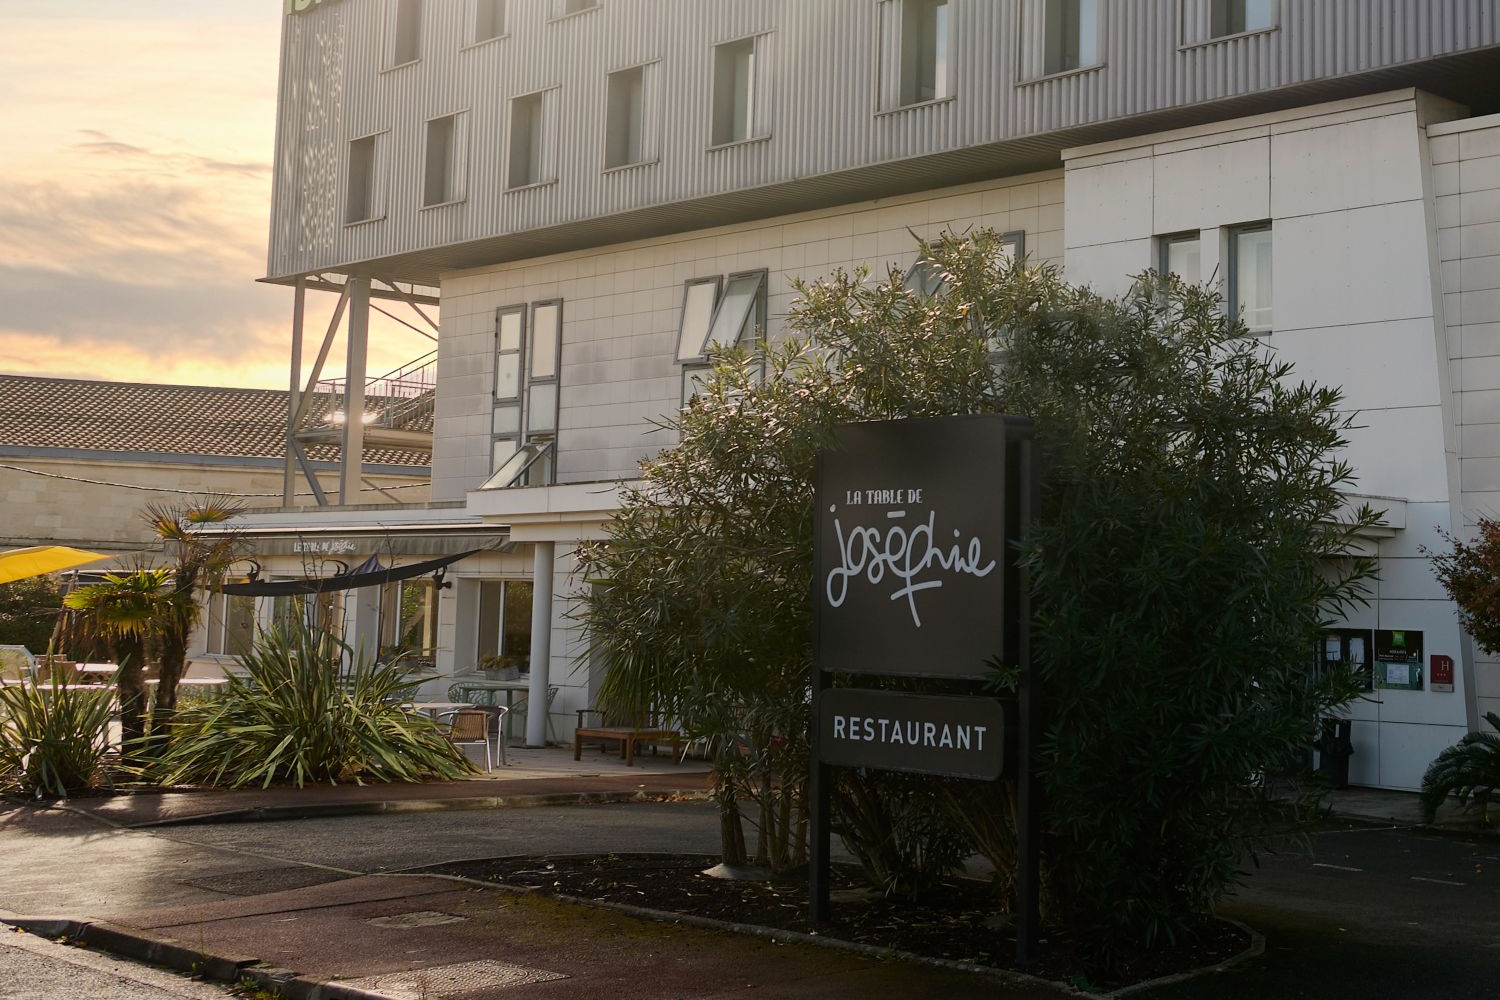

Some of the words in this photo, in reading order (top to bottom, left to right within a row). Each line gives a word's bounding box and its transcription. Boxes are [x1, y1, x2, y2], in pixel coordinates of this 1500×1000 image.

[847, 490, 862, 505] LA
[866, 489, 904, 505] TABLE
[907, 488, 923, 504] DE
[1441, 660, 1449, 671] H
[833, 715, 987, 751] RESTAURANT
